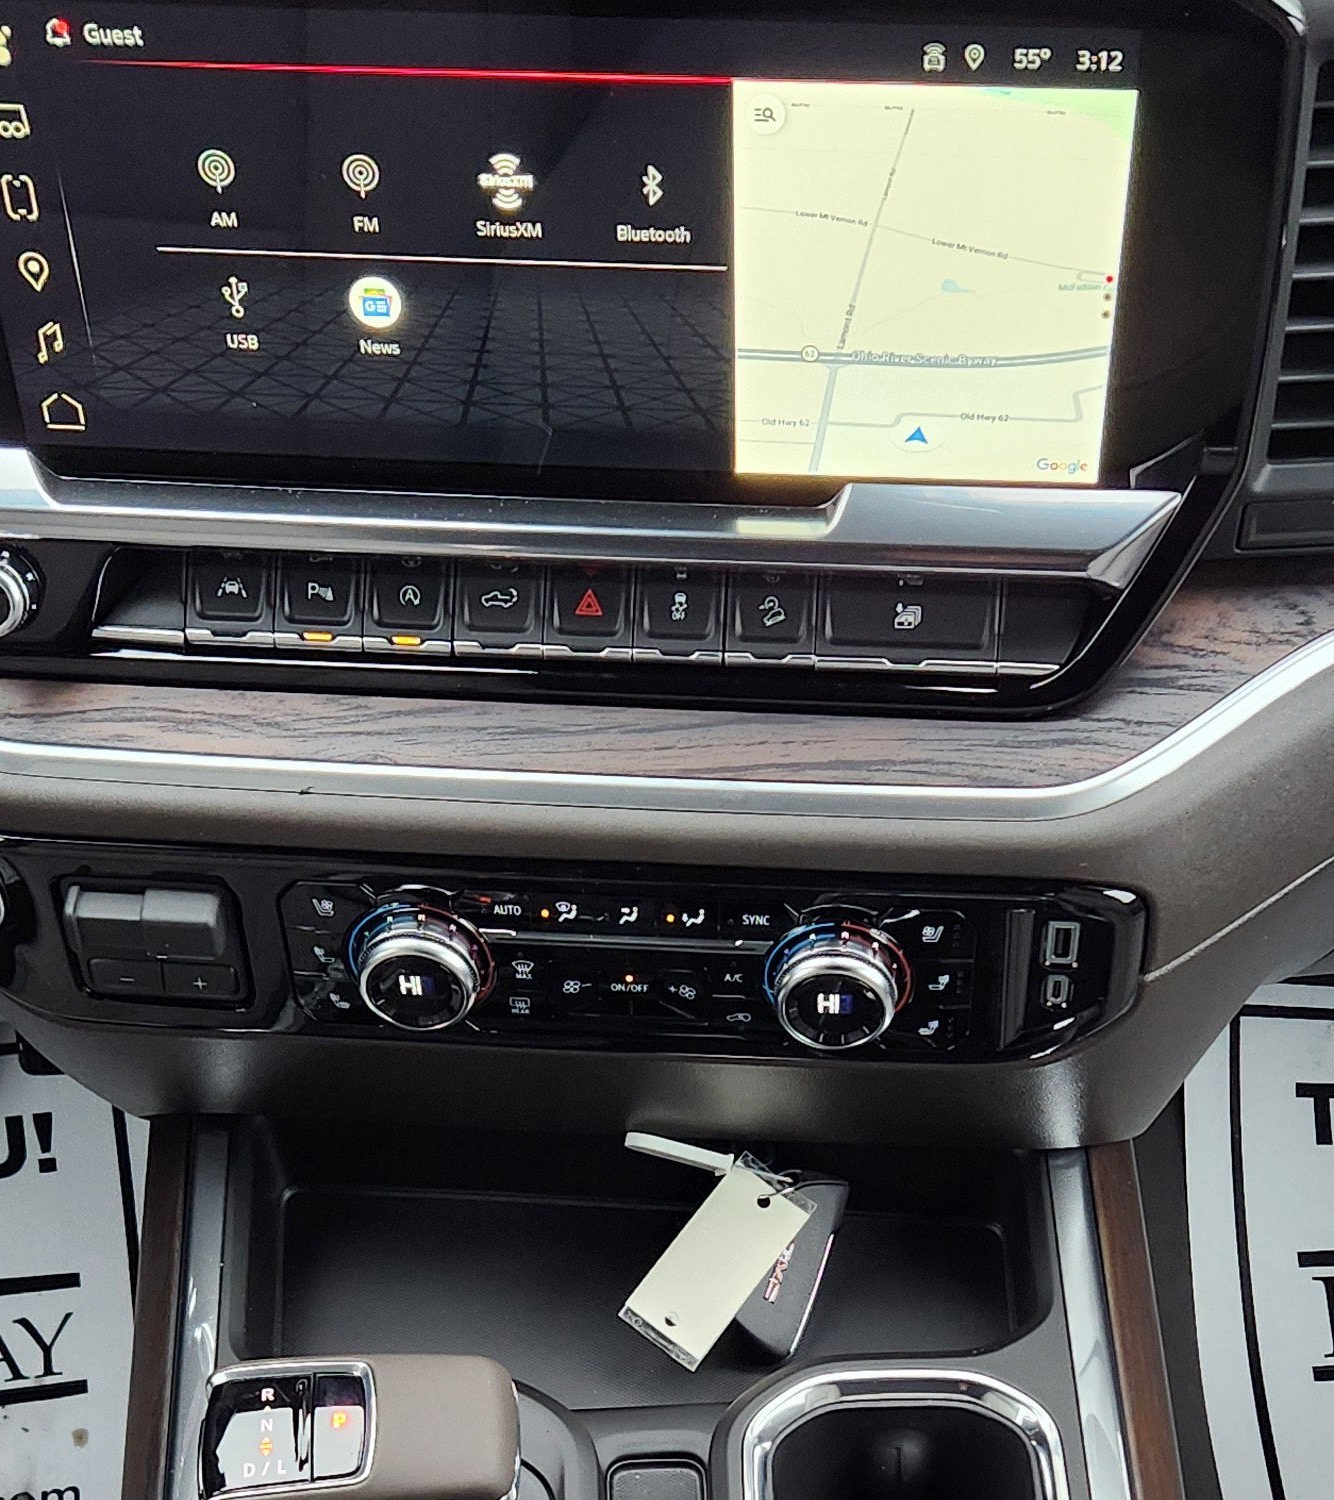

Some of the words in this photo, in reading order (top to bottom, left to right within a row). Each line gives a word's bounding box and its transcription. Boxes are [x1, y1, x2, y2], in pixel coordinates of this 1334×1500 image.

[83, 23, 144, 47] Guest
[1075, 49, 1124, 72] 3:12
[210, 211, 238, 228] AM
[353, 216, 380, 233] FM
[476, 220, 543, 239] SiriusXM
[616, 224, 691, 244] Bluetooth
[226, 333, 259, 351] USB
[359, 339, 402, 355] News
[851, 350, 881, 363] Ohio
[916, 353, 955, 365] Scenic
[958, 354, 998, 368] Byway
[960, 413, 975, 421] Old
[976, 413, 996, 424] Hwy
[998, 414, 1010, 422] 62
[1036, 457, 1088, 474] Google
[493, 904, 522, 916] AUTO
[742, 914, 770, 926] SYNC
[398, 974, 423, 996] HI
[723, 973, 744, 983] A/C
[610, 982, 649, 994] ON/OFF
[817, 992, 840, 1014] HI
[261, 1388, 275, 1401] R
[260, 1418, 273, 1432] N
[332, 1411, 348, 1429] P
